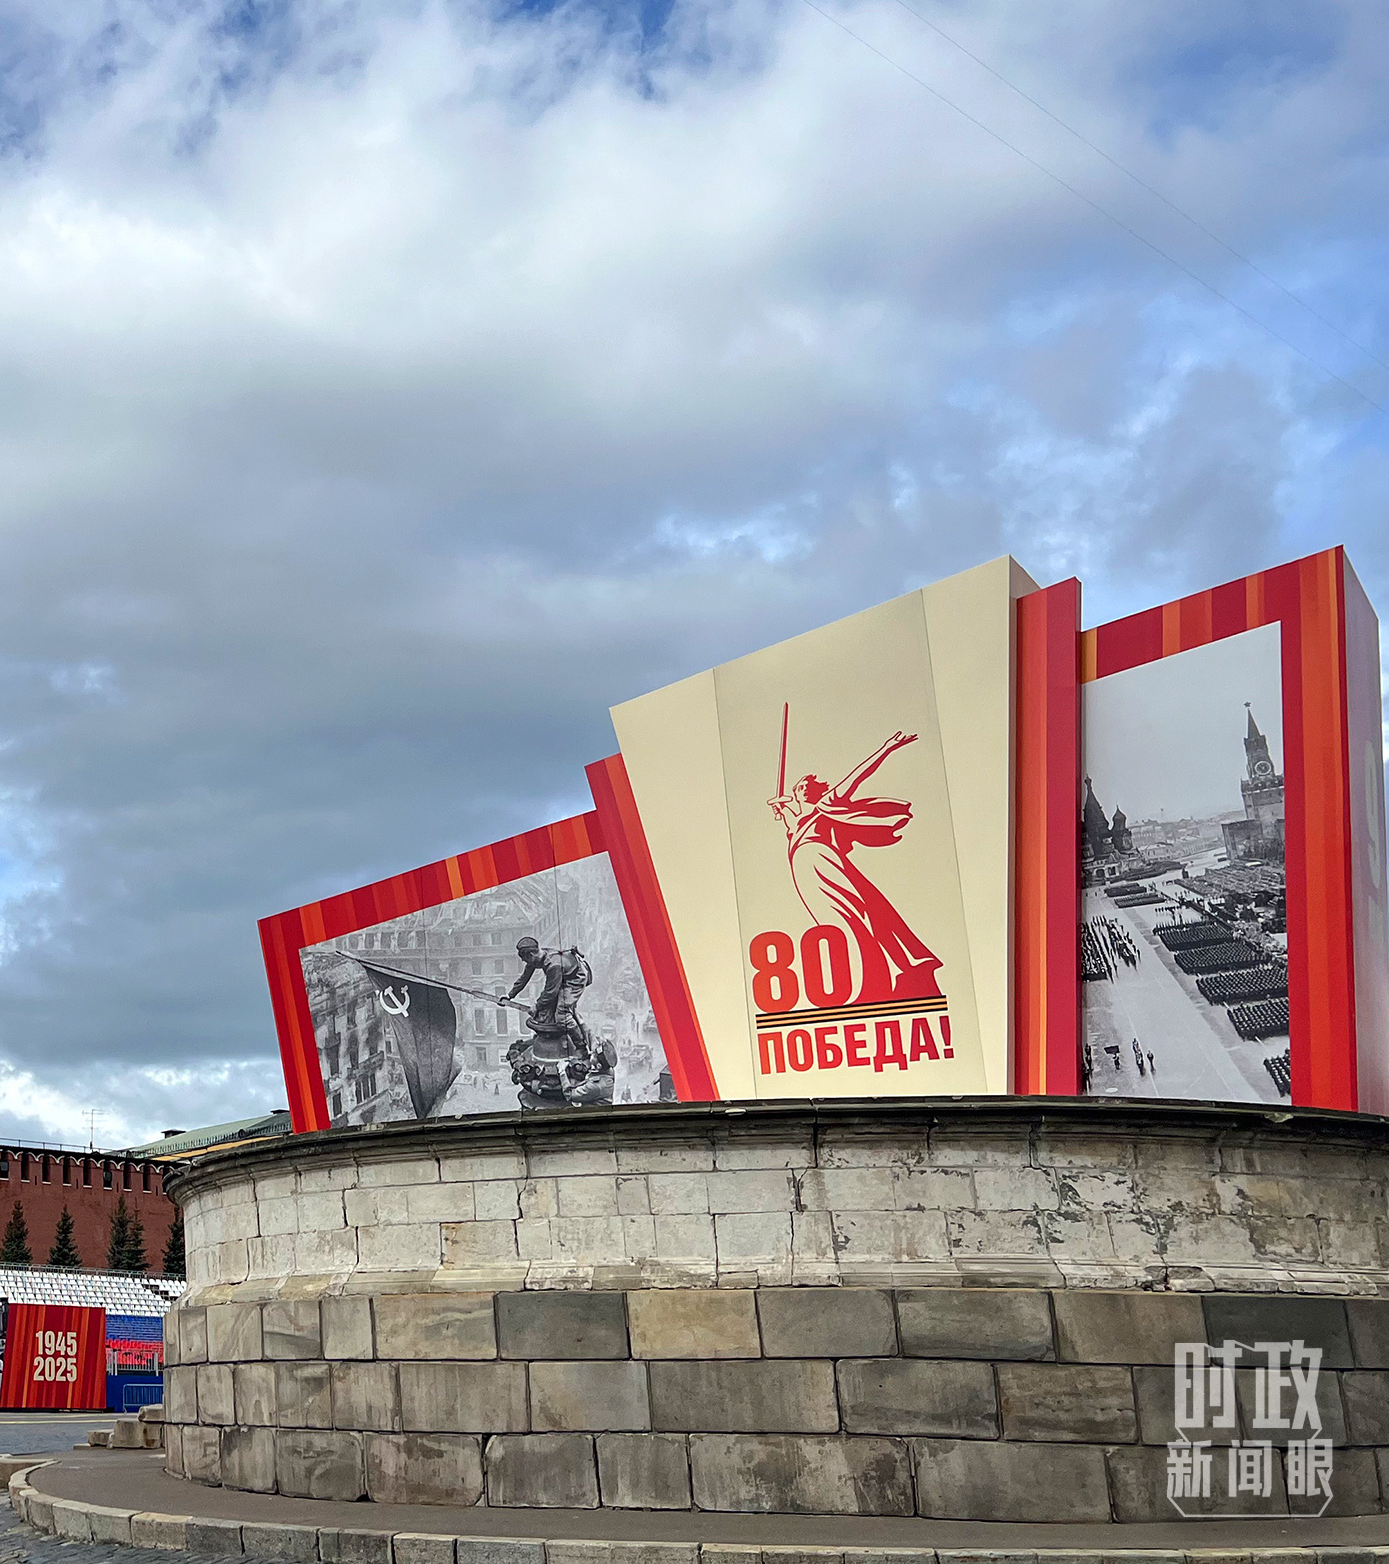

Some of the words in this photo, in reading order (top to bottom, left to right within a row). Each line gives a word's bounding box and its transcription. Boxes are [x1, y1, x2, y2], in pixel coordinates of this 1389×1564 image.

[749, 924, 853, 1014] 80
[757, 1015, 955, 1075] ПОБЕДА!
[35, 1330, 78, 1356] 1945
[33, 1356, 78, 1382] 2025
